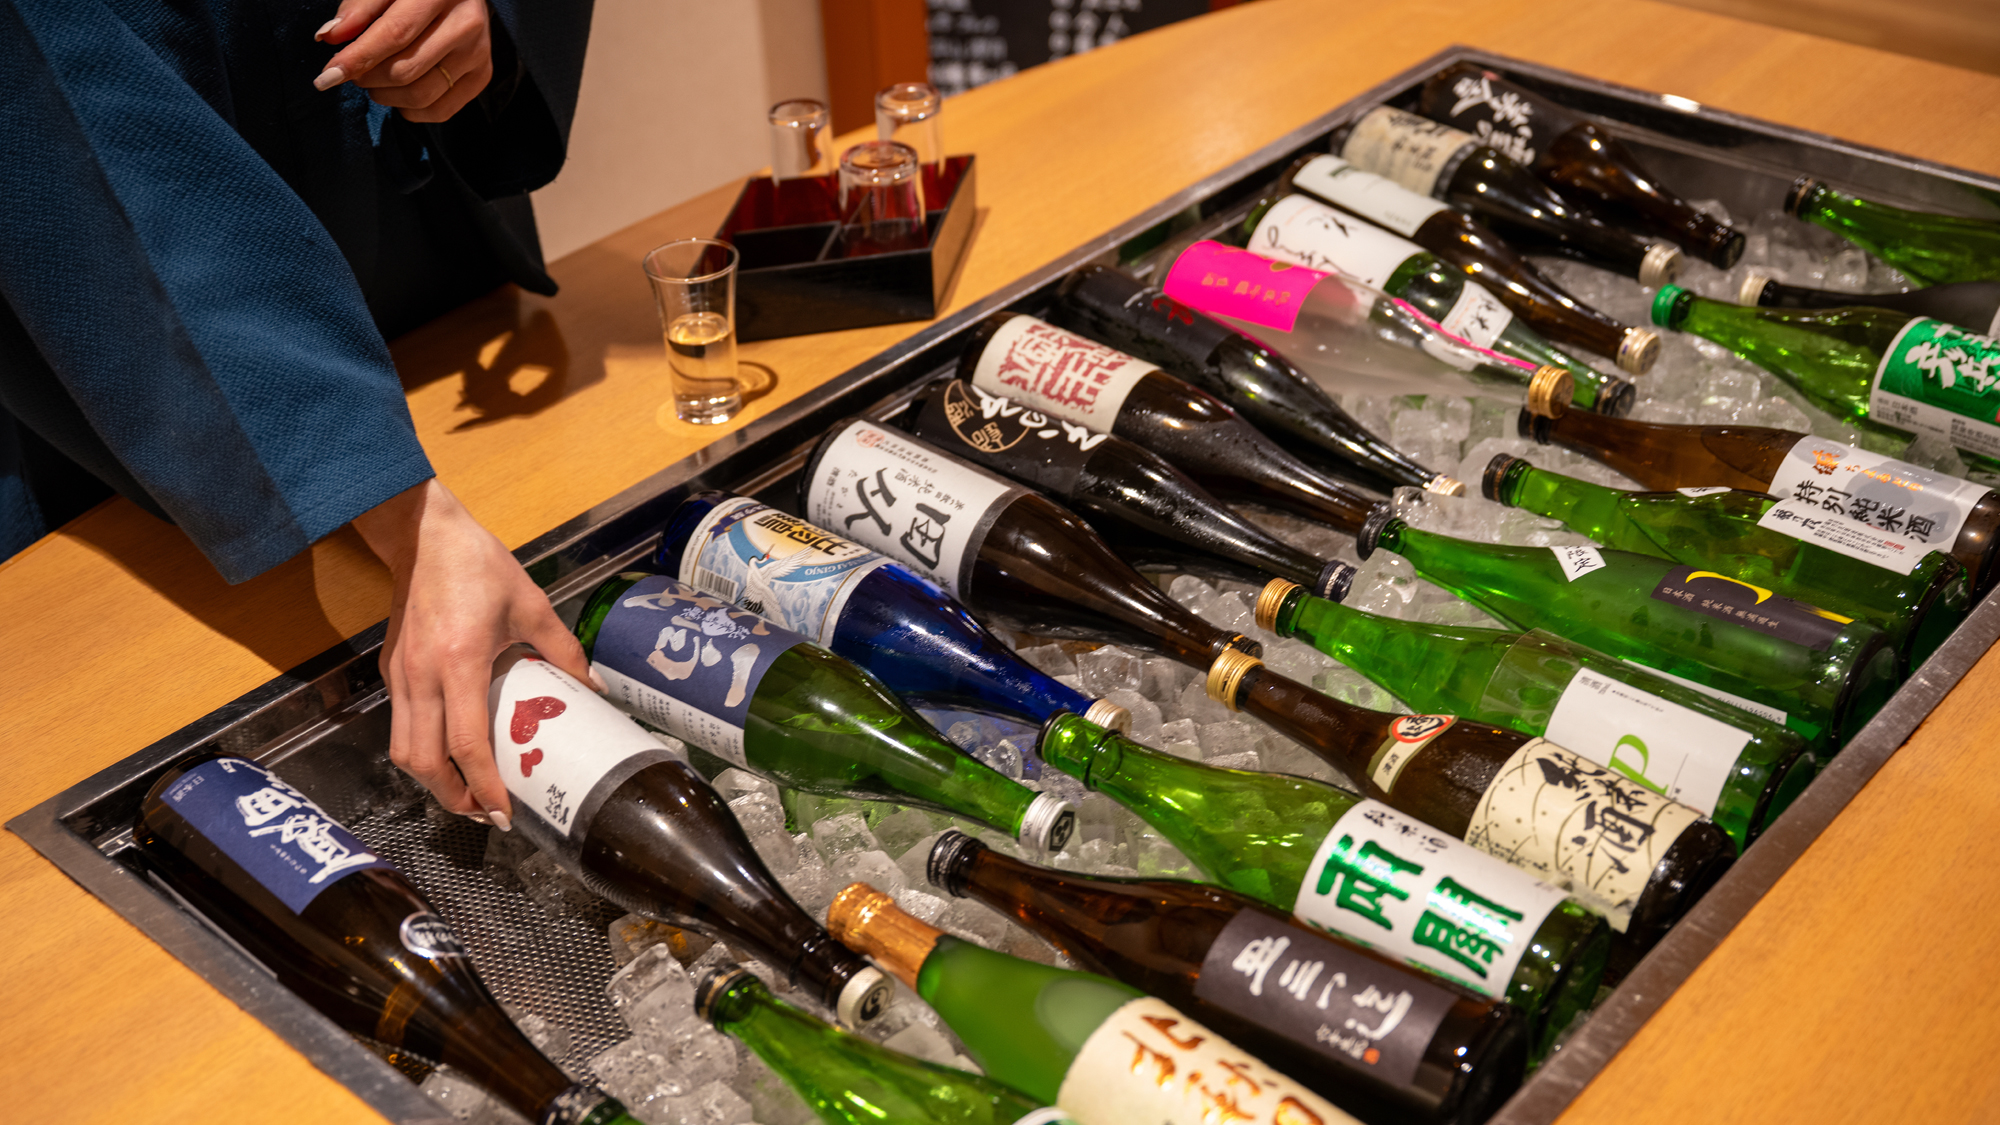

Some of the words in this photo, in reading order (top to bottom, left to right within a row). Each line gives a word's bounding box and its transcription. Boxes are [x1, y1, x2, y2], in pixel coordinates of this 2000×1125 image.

[1794, 479, 1936, 543] 特別純米酒
[804, 566, 838, 576] GINJO
[1663, 586, 1695, 602] 日本酒
[1701, 599, 1733, 614] 純米酒
